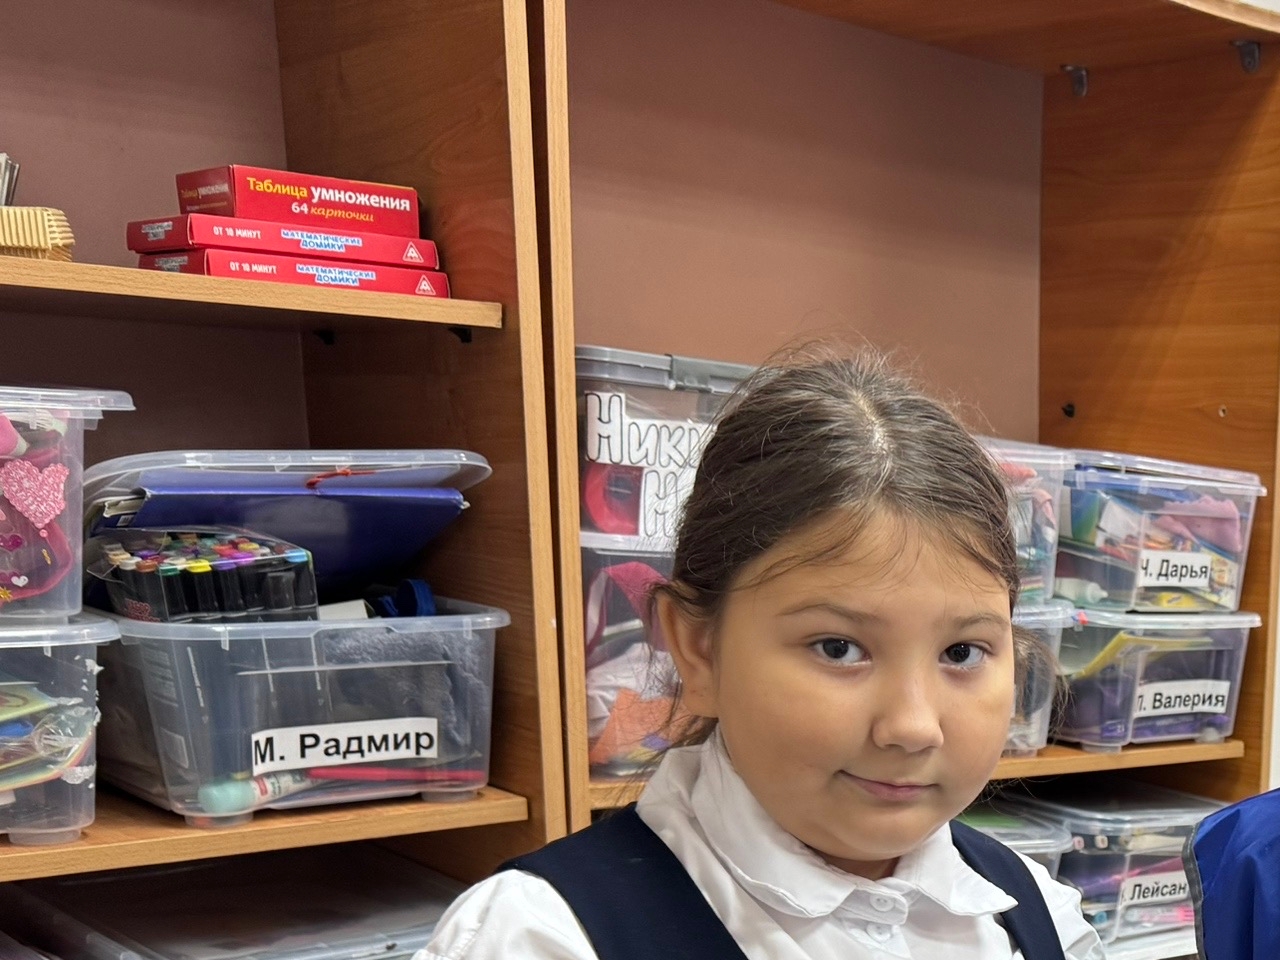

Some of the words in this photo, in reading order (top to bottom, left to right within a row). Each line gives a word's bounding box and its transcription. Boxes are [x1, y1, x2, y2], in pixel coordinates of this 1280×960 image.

[246, 177, 308, 200] Таблица
[310, 186, 411, 212] умножения
[291, 202, 309, 215] 64
[310, 205, 374, 223] карточки
[213, 226, 223, 236] ОТ
[225, 227, 235, 237] 10
[235, 228, 261, 240] МИНУТ
[281, 229, 363, 247] МАТЕМАТИЧЕСКИЕ
[300, 239, 346, 253] ДОМИКИ
[229, 261, 240, 272] ОТ
[241, 263, 251, 273] 10
[251, 263, 277, 274] МИНУТ
[296, 264, 377, 281] МАТЕМАТИЧЕСКИЕ
[315, 274, 360, 286] ДОМИКИ
[1157, 559, 1209, 583] Дарья
[1152, 692, 1226, 712] Валерия
[254, 736, 286, 766] М.
[299, 730, 436, 760] Радмир
